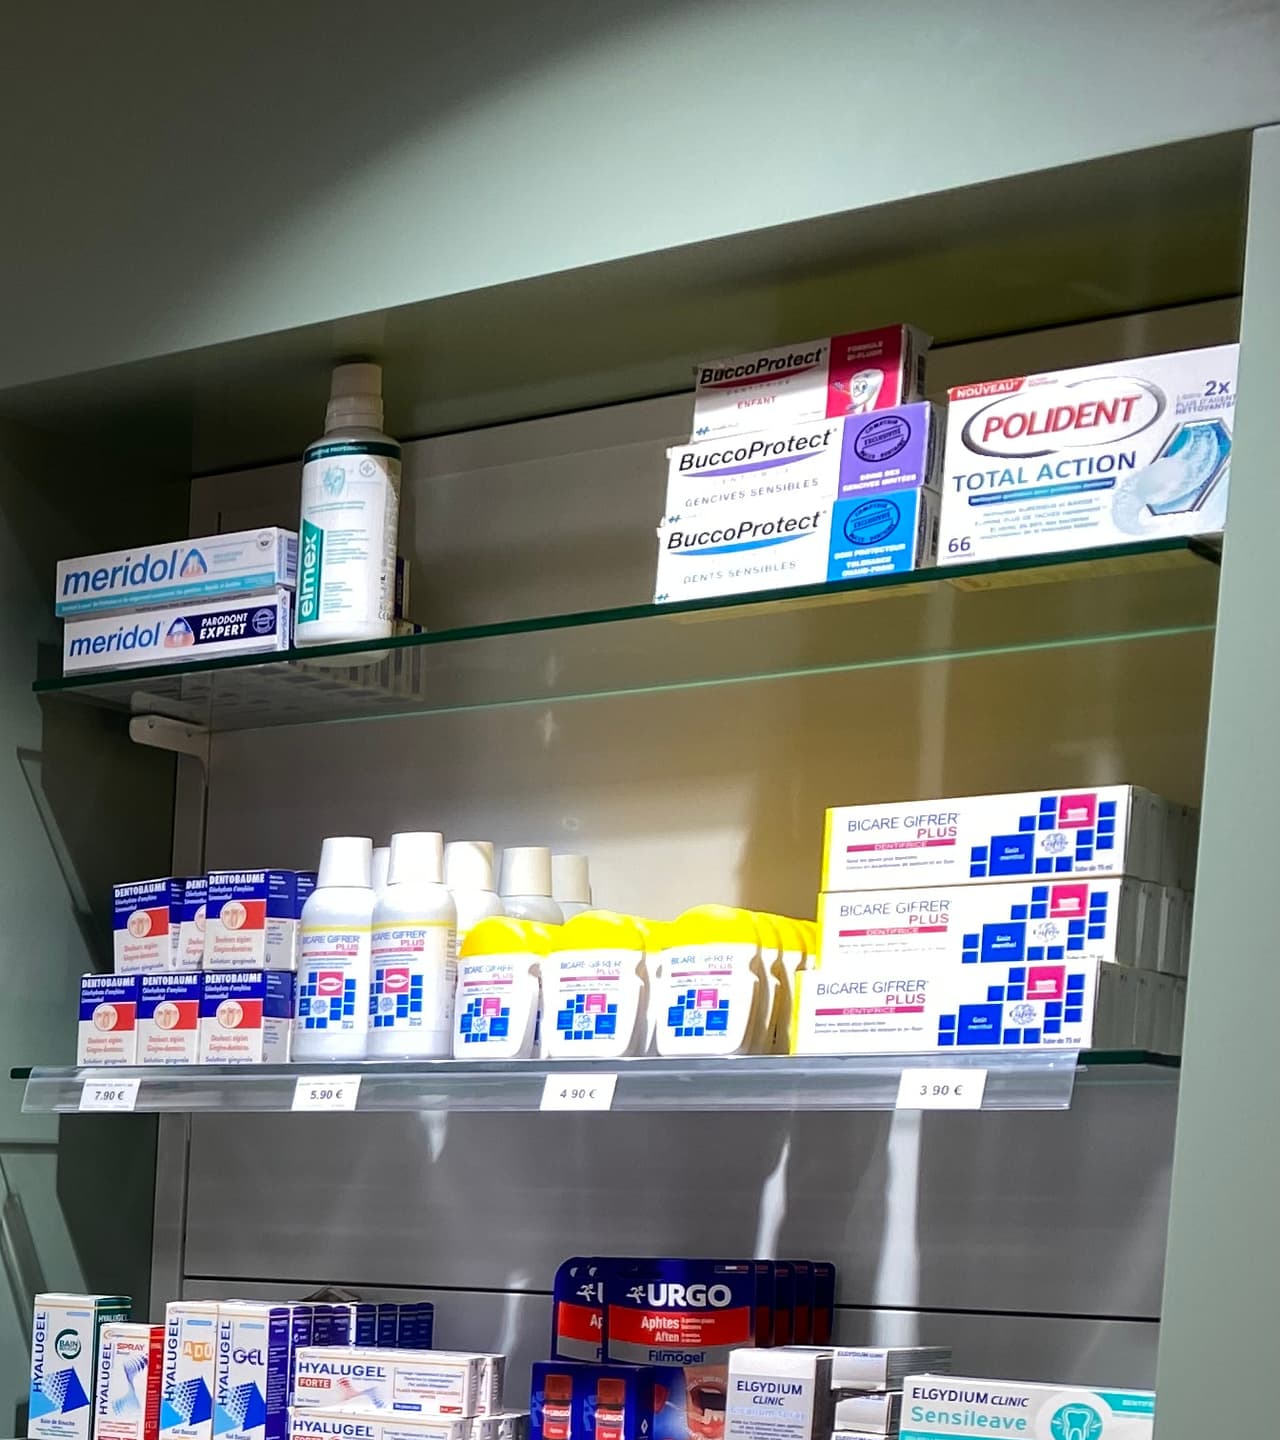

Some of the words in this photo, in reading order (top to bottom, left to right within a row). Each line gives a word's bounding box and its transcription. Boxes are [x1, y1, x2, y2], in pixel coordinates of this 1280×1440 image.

[700, 348, 822, 384] BuccoProtect
[737, 396, 776, 409] ENFANT
[982, 395, 1143, 443] POLIDENT
[678, 428, 830, 472] BuccoProtect
[952, 467, 1027, 493] TOTAL
[1037, 451, 1137, 480] ACTION
[685, 490, 746, 507] GENCIVES
[750, 478, 819, 496] SENSIBLES
[667, 512, 820, 550] BuccoProtect
[948, 536, 971, 553] 66
[62, 549, 175, 596] meridol
[299, 535, 320, 617] elmex
[683, 571, 723, 584] DENTS
[728, 562, 796, 578] SENSIBLES
[198, 620, 248, 639] EXPERT
[201, 613, 248, 628] PARODONT
[69, 622, 162, 657] meridol
[847, 817, 899, 833] BICARE
[903, 813, 958, 829] GIFRER
[917, 826, 957, 839] PLUS
[874, 840, 928, 851] DENTIFRICE
[209, 872, 265, 885] DENTOBAUME
[114, 881, 166, 898] DENTOBAUME
[840, 903, 891, 918] BICARE
[896, 900, 950, 914] GIFRER
[909, 913, 950, 926] PLUS
[816, 982, 869, 996] BICARE
[872, 979, 927, 993] GIFRER
[885, 993, 926, 1005] PLUS
[95, 1090, 114, 1101] 7.90
[116, 1091, 124, 1101] €
[310, 1089, 332, 1100] 5.90
[335, 1089, 343, 1100] €
[648, 1283, 732, 1308] URGO
[641, 1316, 679, 1331] Aphtes
[59, 1340, 78, 1348] BAIN
[655, 1331, 679, 1343] Aften
[33, 1311, 47, 1393] HYALUGEL
[116, 1343, 145, 1352] SPRAY
[183, 1341, 212, 1360] ADO
[165, 1317, 180, 1402] HYALUGEL
[232, 1347, 264, 1367] GEL
[648, 1350, 705, 1364] Filmogel
[99, 1342, 113, 1415] HYALUGEL
[299, 1378, 330, 1388] FORTE
[737, 1381, 803, 1395] ELGYDIUM
[753, 1395, 785, 1406] CLINIC
[912, 1387, 989, 1404] ELGYDIUM
[990, 1395, 1029, 1408] CLINIC
[911, 1407, 1027, 1431] Sensileave
